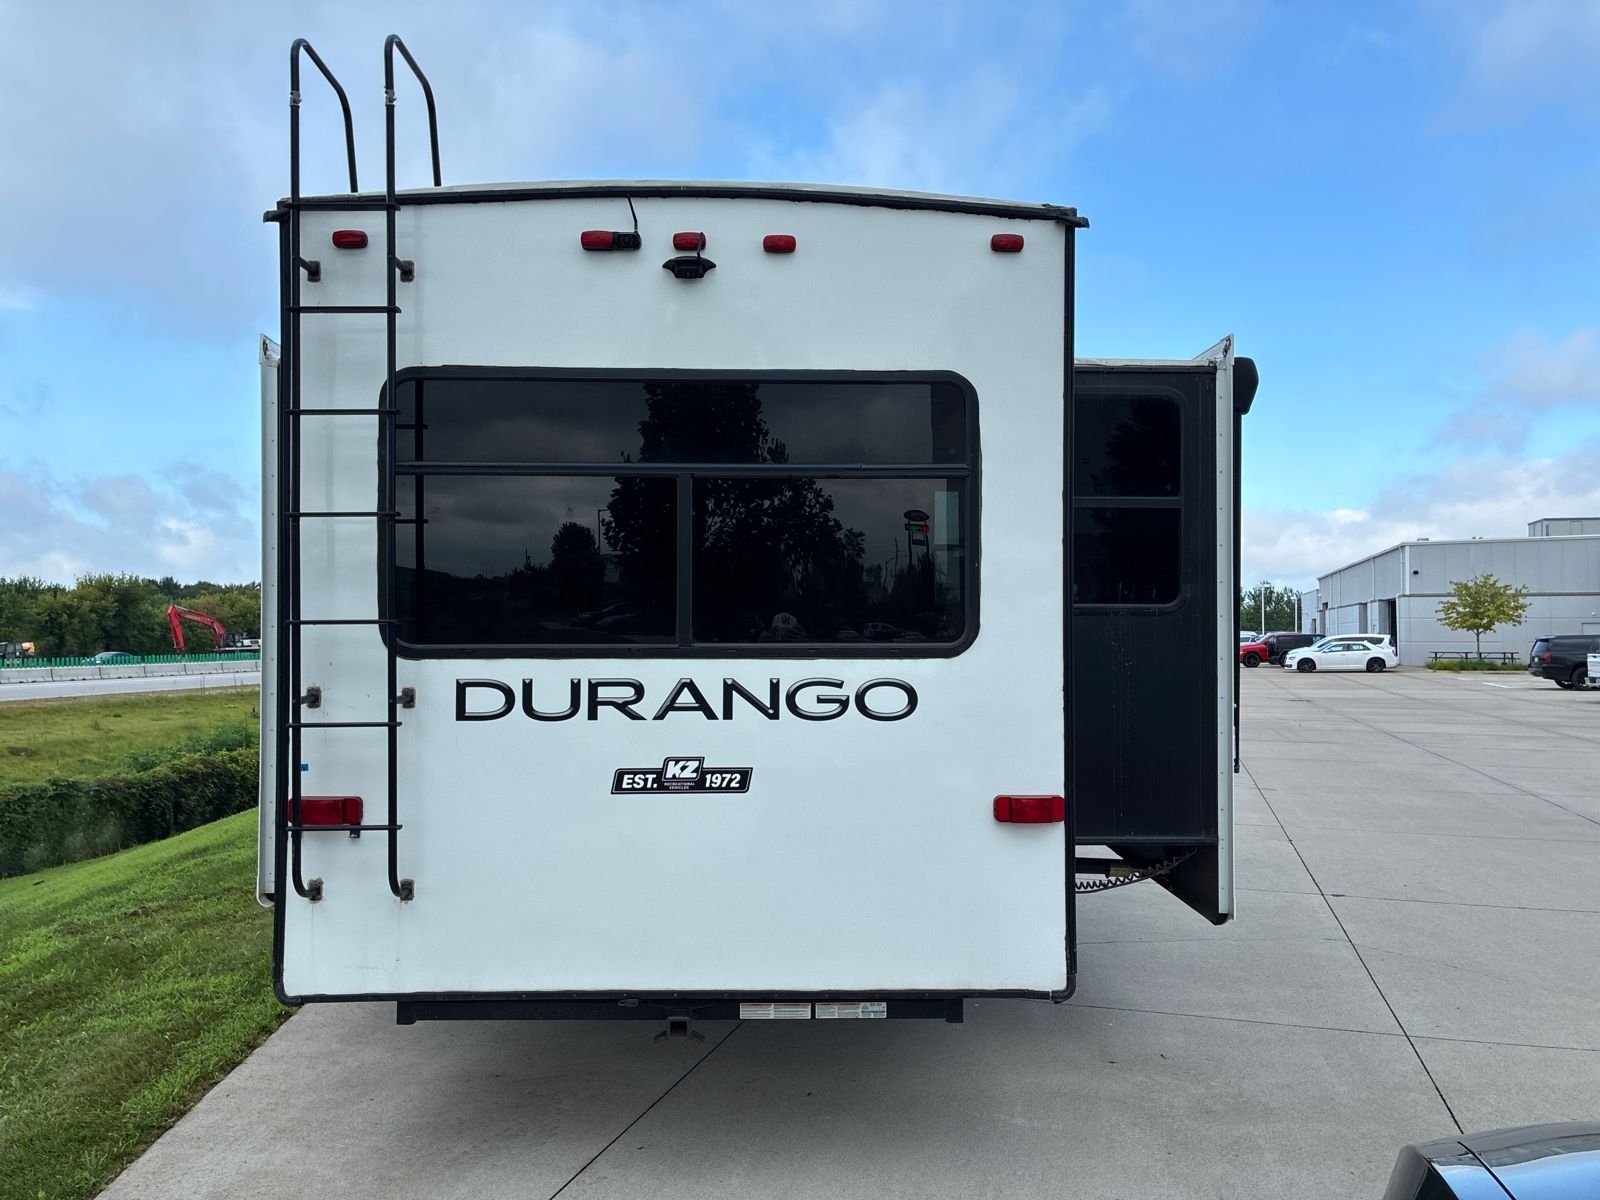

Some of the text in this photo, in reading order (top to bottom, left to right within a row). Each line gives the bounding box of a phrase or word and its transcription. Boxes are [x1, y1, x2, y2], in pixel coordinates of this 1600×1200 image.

[455, 677, 919, 722] DURANGO
[665, 761, 700, 778] KZ
[622, 774, 741, 789] EST. 1972
